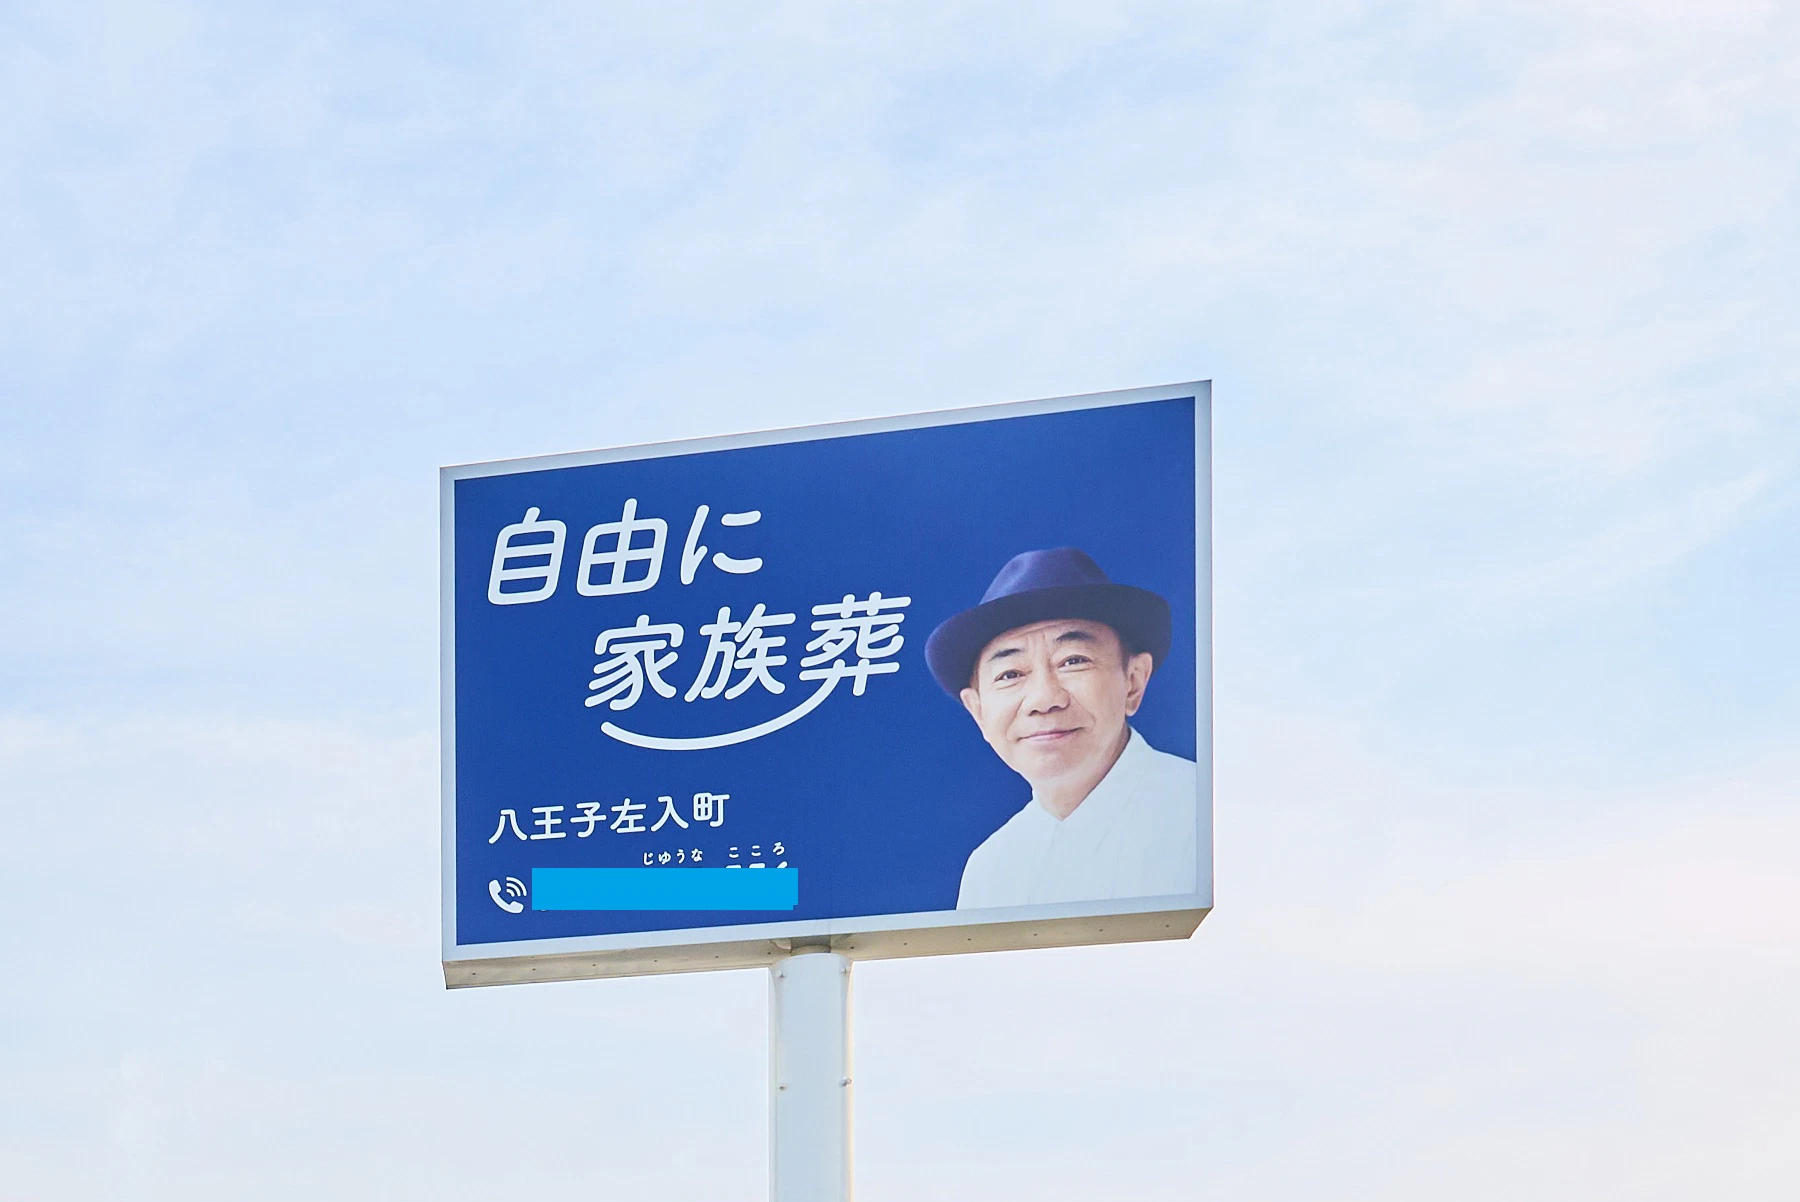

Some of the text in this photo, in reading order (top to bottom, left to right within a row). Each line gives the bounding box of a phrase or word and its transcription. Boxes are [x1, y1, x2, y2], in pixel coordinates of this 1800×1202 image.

[487, 497, 763, 606] 自由に
[584, 591, 912, 712] 家族葬
[488, 792, 731, 844] 八王子左入町
[728, 841, 785, 859] こころ
